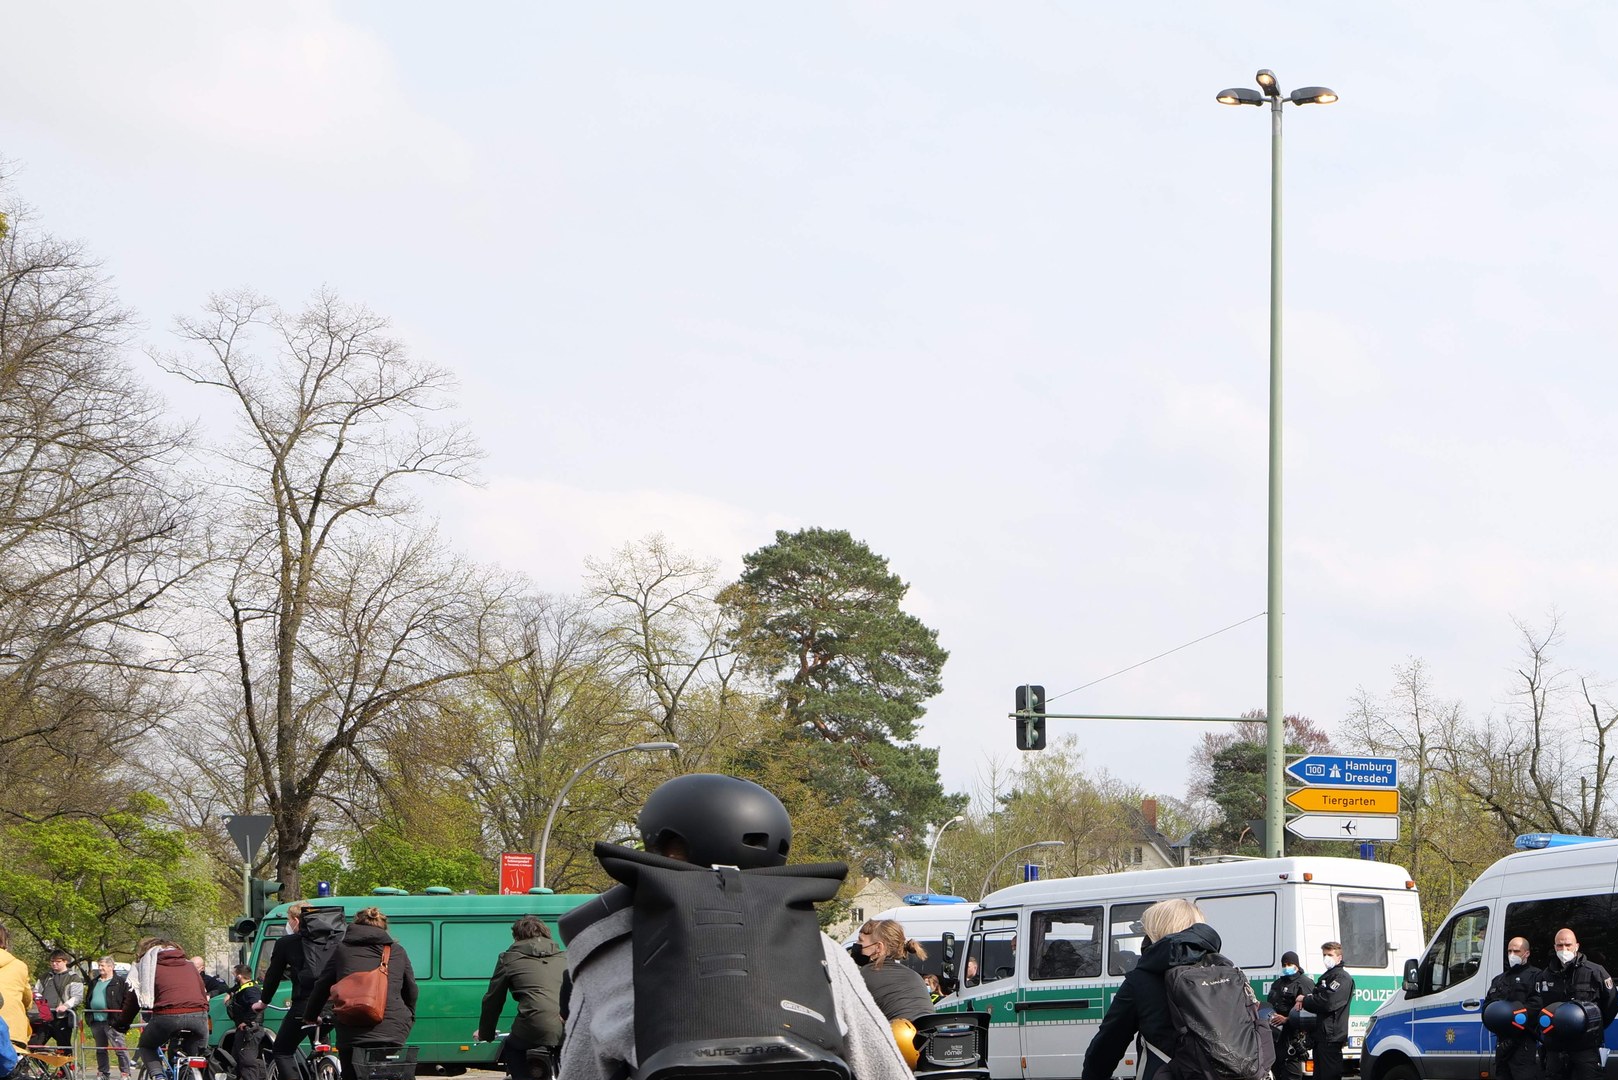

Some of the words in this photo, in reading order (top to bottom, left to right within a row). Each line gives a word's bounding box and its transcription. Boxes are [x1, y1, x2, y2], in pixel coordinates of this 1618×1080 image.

[1309, 766, 1322, 774] 100
[1345, 760, 1392, 774] Hamburg
[1345, 773, 1388, 783] Dresden
[1322, 795, 1376, 807] Tiergarten
[1355, 988, 1396, 1002] POLIZE
